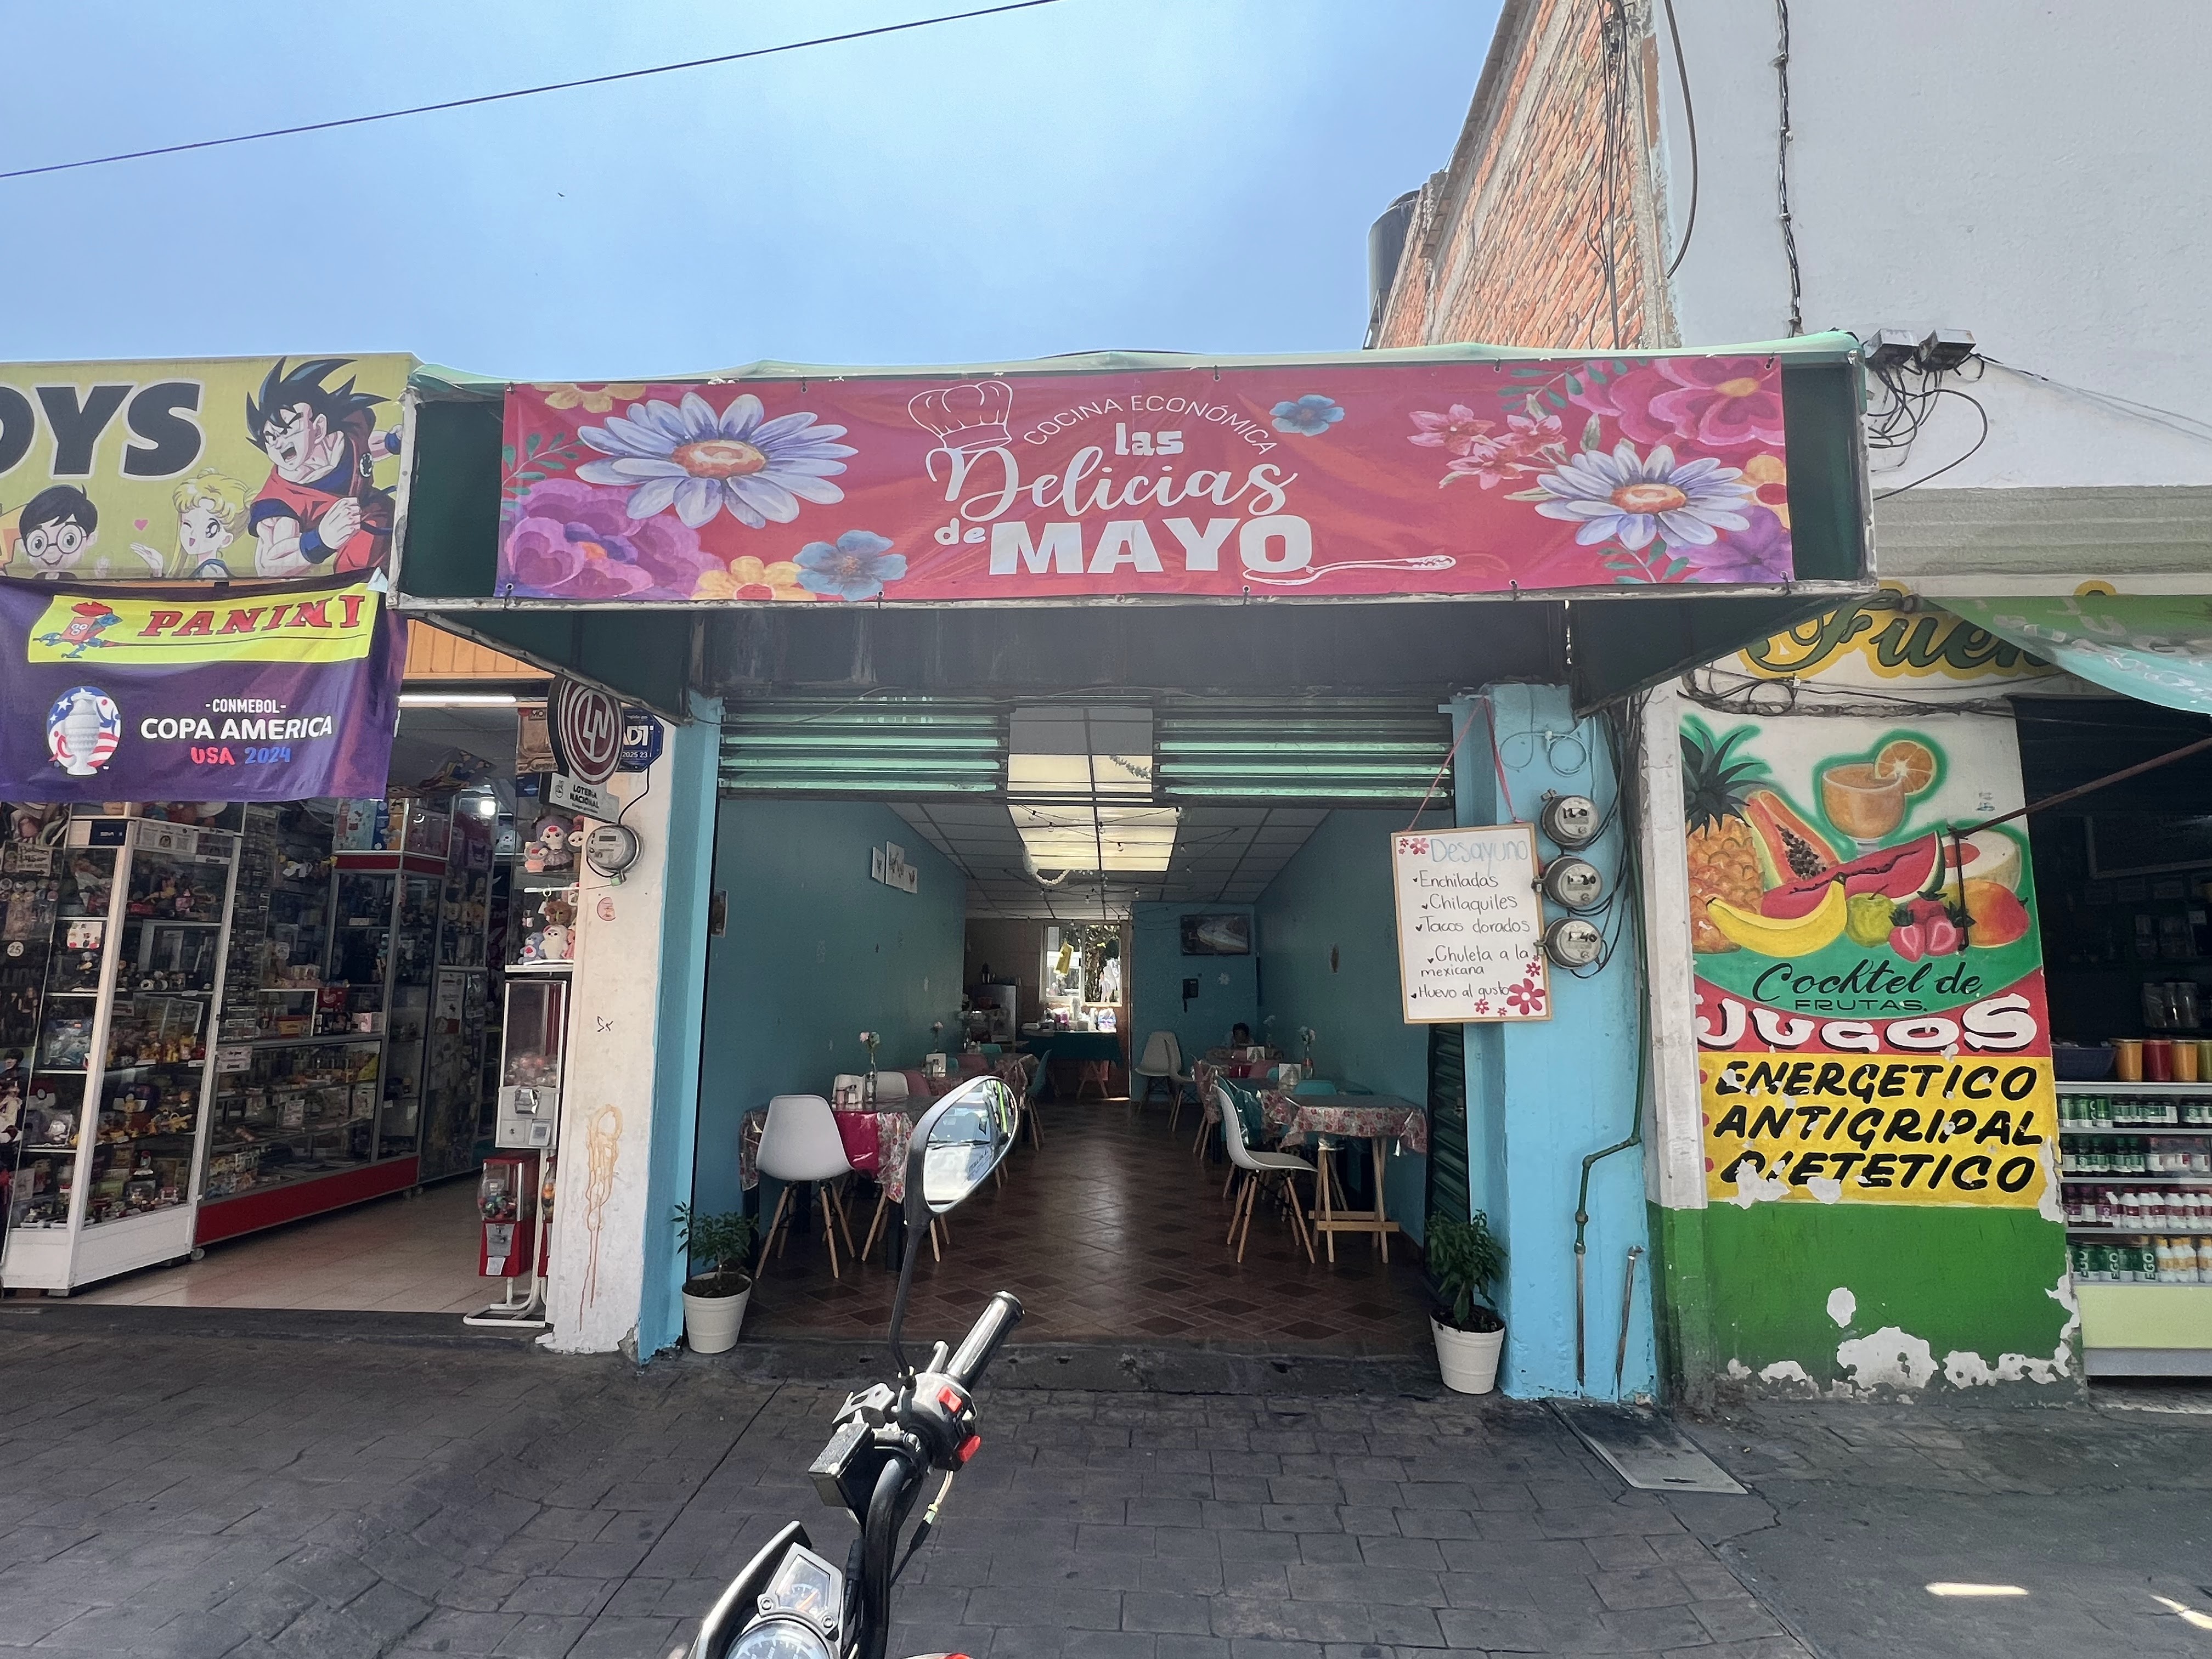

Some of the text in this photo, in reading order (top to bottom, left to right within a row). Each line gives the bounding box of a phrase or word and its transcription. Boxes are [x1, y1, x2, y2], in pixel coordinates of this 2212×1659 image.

[1024, 394, 1277, 455] COCINA ECONÓMICA
[1115, 422, 1184, 456] las
[926, 445, 1299, 522] Delicias
[933, 514, 1313, 575] de MAYO
[137, 594, 366, 637] PANINI
[140, 715, 333, 740] COPA AMERICA
[190, 746, 291, 765] USA 2024
[1430, 838, 1528, 877] Desayuno
[1419, 870, 1499, 888] Enchiladas
[1429, 893, 1518, 915] Chilaquiles
[1419, 915, 1531, 934] Tacos dorados
[10, 945, 21, 954] 25
[1435, 944, 1528, 962] Chuleta a la
[1420, 964, 1485, 978] mexicana
[1752, 958, 1984, 1003] Cocktel de
[1419, 981, 1510, 1000] Huevo al gusto
[1695, 993, 2038, 1054] JUGOS
[1714, 1061, 2038, 1104] ENERGETICO
[1713, 1105, 2043, 1152] ANTIGRIPAL
[2109, 1252, 2120, 1280] EGO
[2143, 1252, 2156, 1280] EGO
